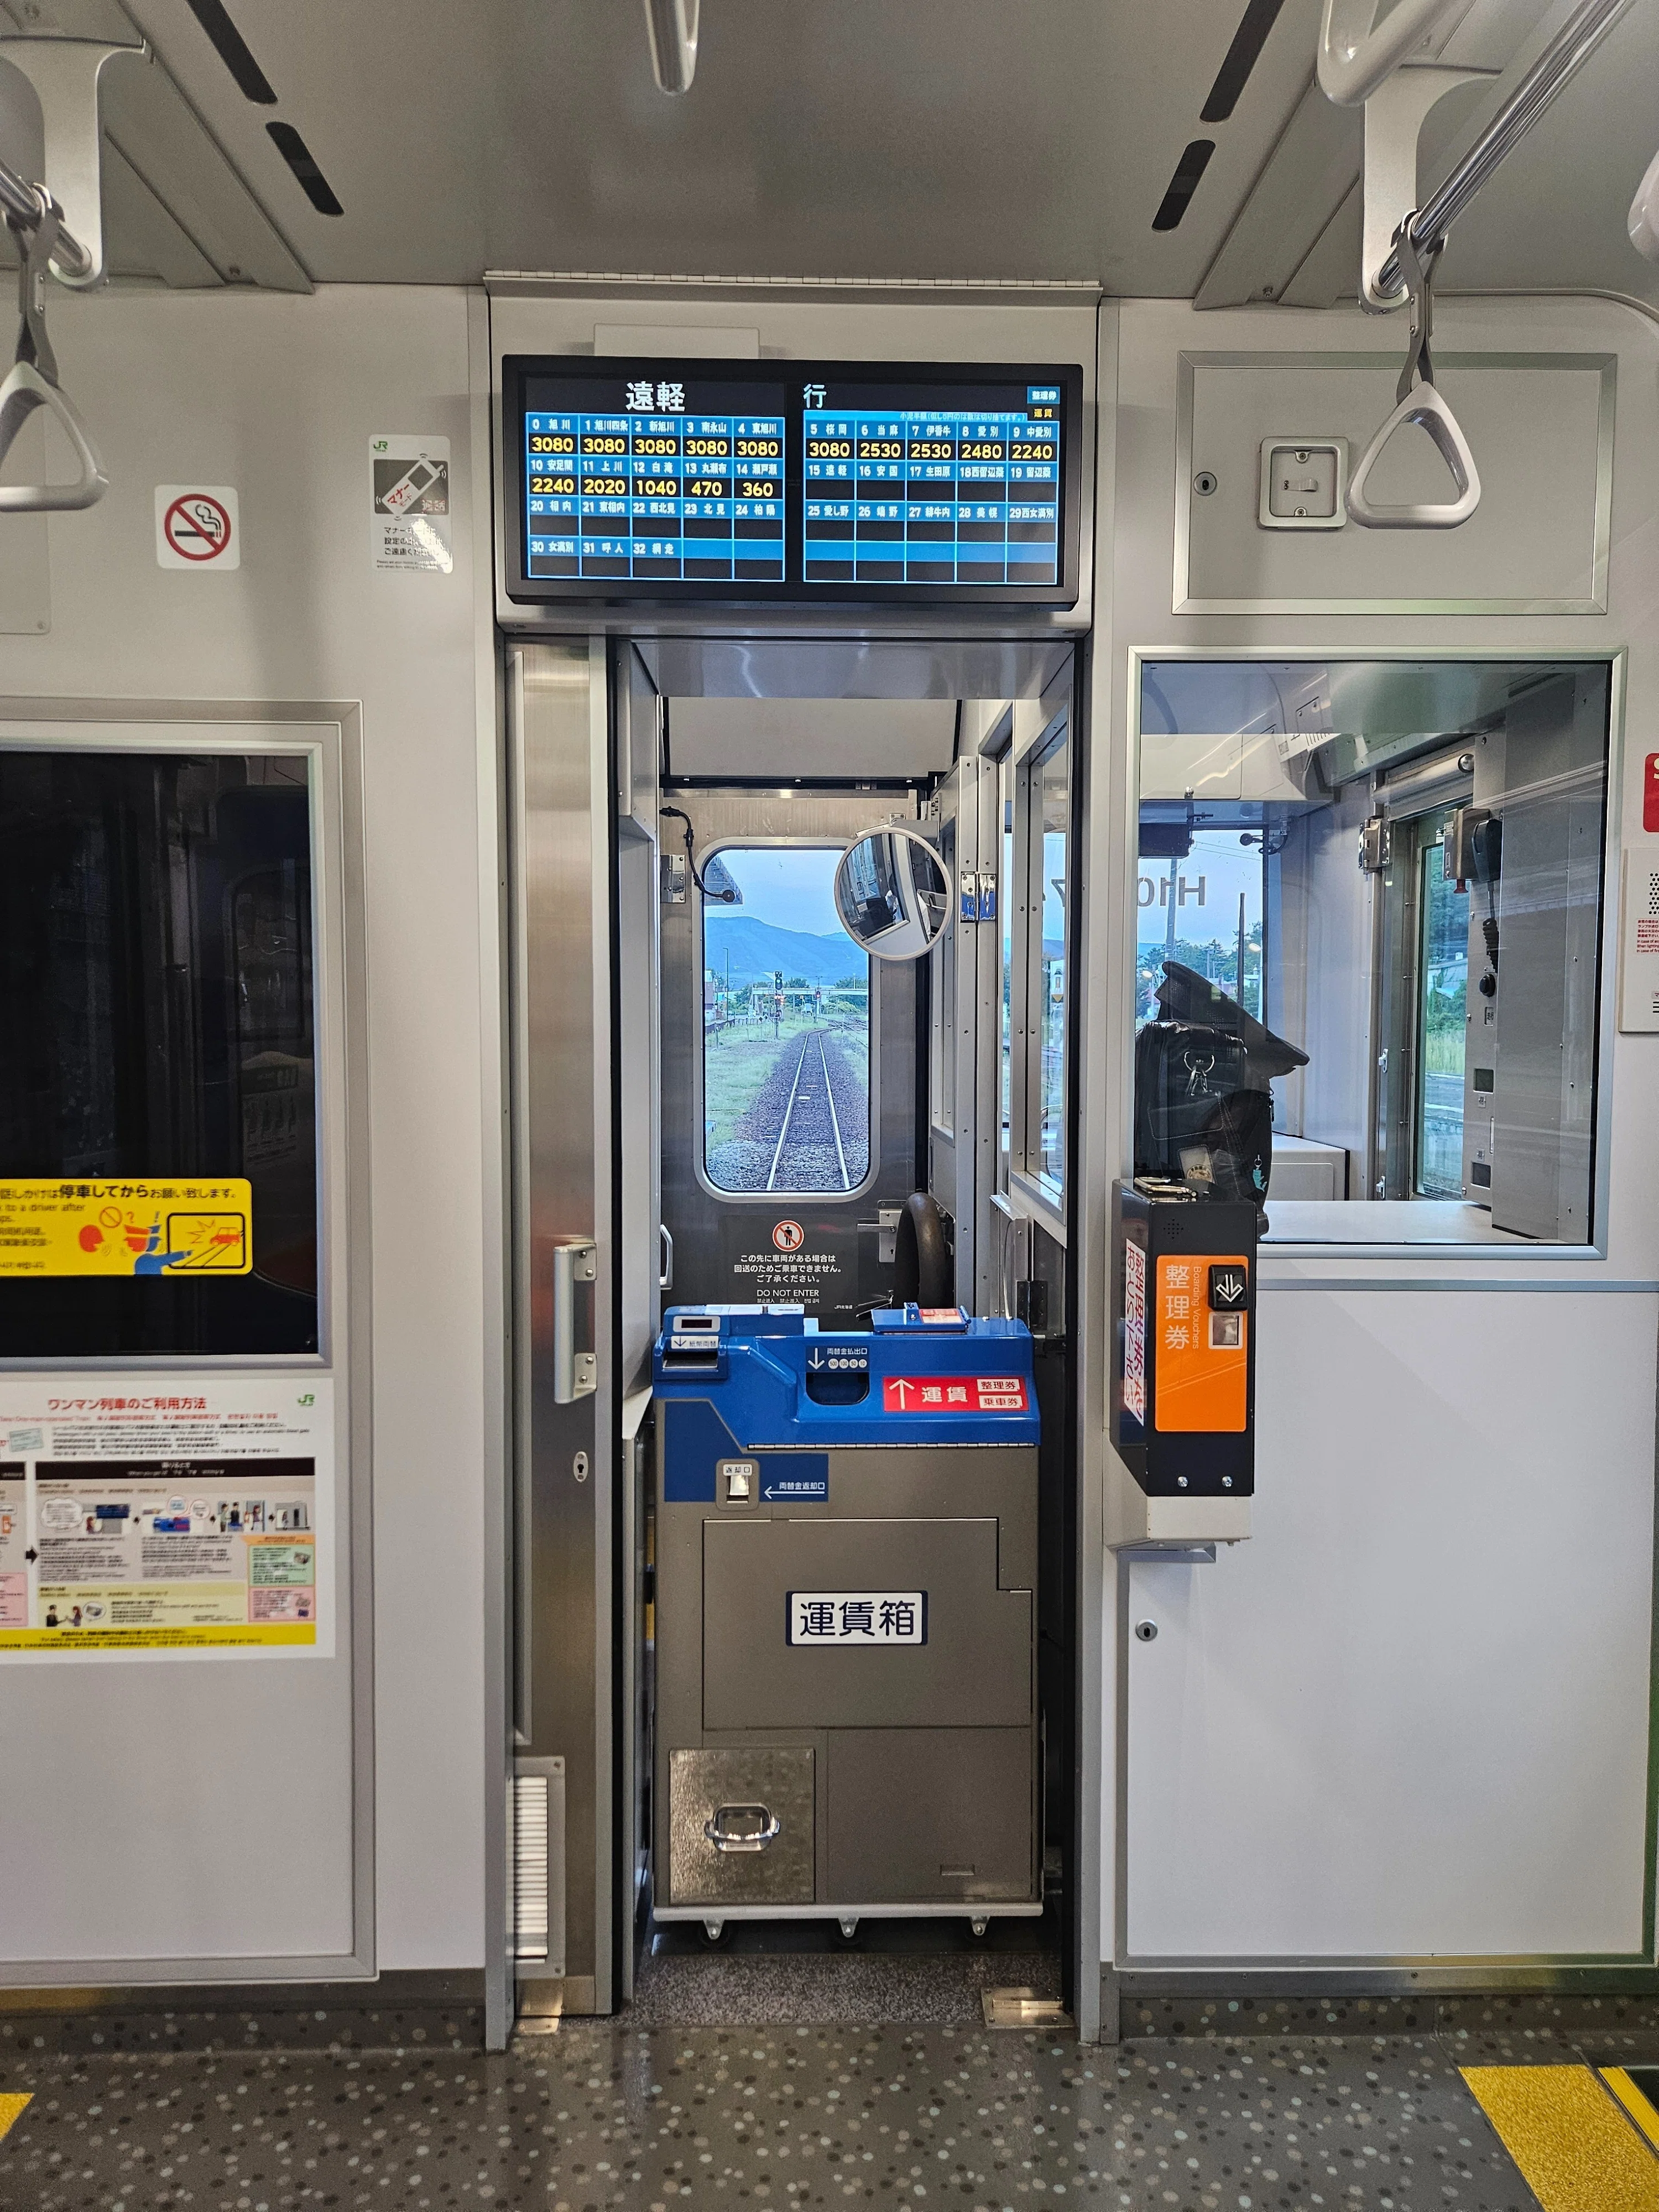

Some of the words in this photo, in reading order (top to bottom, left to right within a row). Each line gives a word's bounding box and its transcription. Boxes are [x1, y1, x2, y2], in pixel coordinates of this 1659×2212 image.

[625, 380, 685, 412] 遠軽
[803, 383, 827, 409] 行
[1032, 390, 1057, 400] 整理券
[532, 419, 540, 430] 0
[548, 418, 570, 431] 旭川
[585, 420, 591, 431] 1
[594, 419, 628, 432] 旭川四条
[635, 421, 642, 432] 2
[649, 420, 675, 433] 新旭川
[686, 421, 694, 434] 3
[701, 421, 727, 434] 南永山
[738, 422, 745, 435] 4
[752, 422, 777, 435] 東旭川
[810, 424, 818, 435] 5
[826, 423, 847, 436] 桜岡
[861, 425, 869, 436] 6
[877, 424, 899, 436] 当麻
[912, 425, 920, 437] 7
[926, 425, 951, 437] 伊香牛
[962, 426, 969, 437] 8
[978, 425, 999, 437] 愛別
[1013, 426, 1020, 438] 9
[1027, 426, 1052, 438] 中愛別
[373, 441, 388, 449] JR
[531, 436, 573, 452] 3080
[583, 437, 625, 453] 3080
[635, 439, 676, 455] 3080
[686, 440, 728, 456] 3080
[737, 441, 778, 456] 3080
[809, 442, 850, 457] 3080
[860, 442, 901, 458] 2530
[910, 443, 951, 458] 2530
[961, 444, 1002, 459] 2480
[1011, 444, 1052, 460] 2240
[530, 460, 543, 471] 10
[546, 459, 573, 472] 安足間
[582, 460, 594, 472] 11
[601, 460, 623, 473] 上川
[633, 461, 645, 473] 12
[652, 461, 674, 474] 白滝
[685, 462, 697, 474] 13
[701, 462, 727, 474] 丸瀬布
[736, 463, 748, 475] 14
[752, 463, 778, 476] 瀬戸瀬
[808, 465, 820, 476] 15
[826, 464, 847, 476] 遠軽
[859, 465, 871, 477] 16
[877, 465, 898, 477] 安国
[910, 466, 922, 477] 17
[926, 466, 951, 478] 生田原
[1011, 467, 1022, 478] 19
[532, 477, 574, 493] 2240
[583, 478, 625, 494] 2020
[637, 480, 676, 495] 1040
[691, 481, 722, 496] 470
[742, 482, 773, 497] 360
[387, 484, 410, 504] マナー
[530, 500, 544, 512] 20
[549, 499, 571, 513] 相内
[582, 501, 594, 513] 21
[599, 500, 625, 513] 東相内
[633, 502, 646, 514] 22
[649, 502, 676, 514] 西北見
[684, 503, 697, 515] 23
[703, 503, 726, 515] 北見
[735, 504, 749, 516] 24
[754, 504, 775, 516] 柏陽
[807, 505, 820, 517] 25
[823, 505, 849, 517] 愛し野
[858, 506, 871, 518] 26
[909, 507, 921, 518] 27
[958, 507, 971, 518] 28
[977, 507, 998, 519] 美幌
[531, 541, 544, 553] 30
[548, 541, 574, 554] 女満別
[582, 542, 594, 554] 31
[601, 542, 623, 554] 呼人
[633, 542, 646, 555] 32
[652, 542, 674, 555] 網走
[61, 1203, 86, 1211] after
[757, 1275, 820, 1283] ご了承ください。
[1191, 1266, 1202, 1306] Boarding
[1165, 1264, 1190, 1349] 整理券
[1193, 1308, 1201, 1349] Vouchers
[980, 1381, 1016, 1390] 整理券
[922, 1386, 968, 1402] 運賃
[48, 1397, 206, 1410] ワンマン列車のご利用方法
[983, 1397, 1019, 1406] 乗車券
[800, 1600, 915, 1636] 運賃箱
